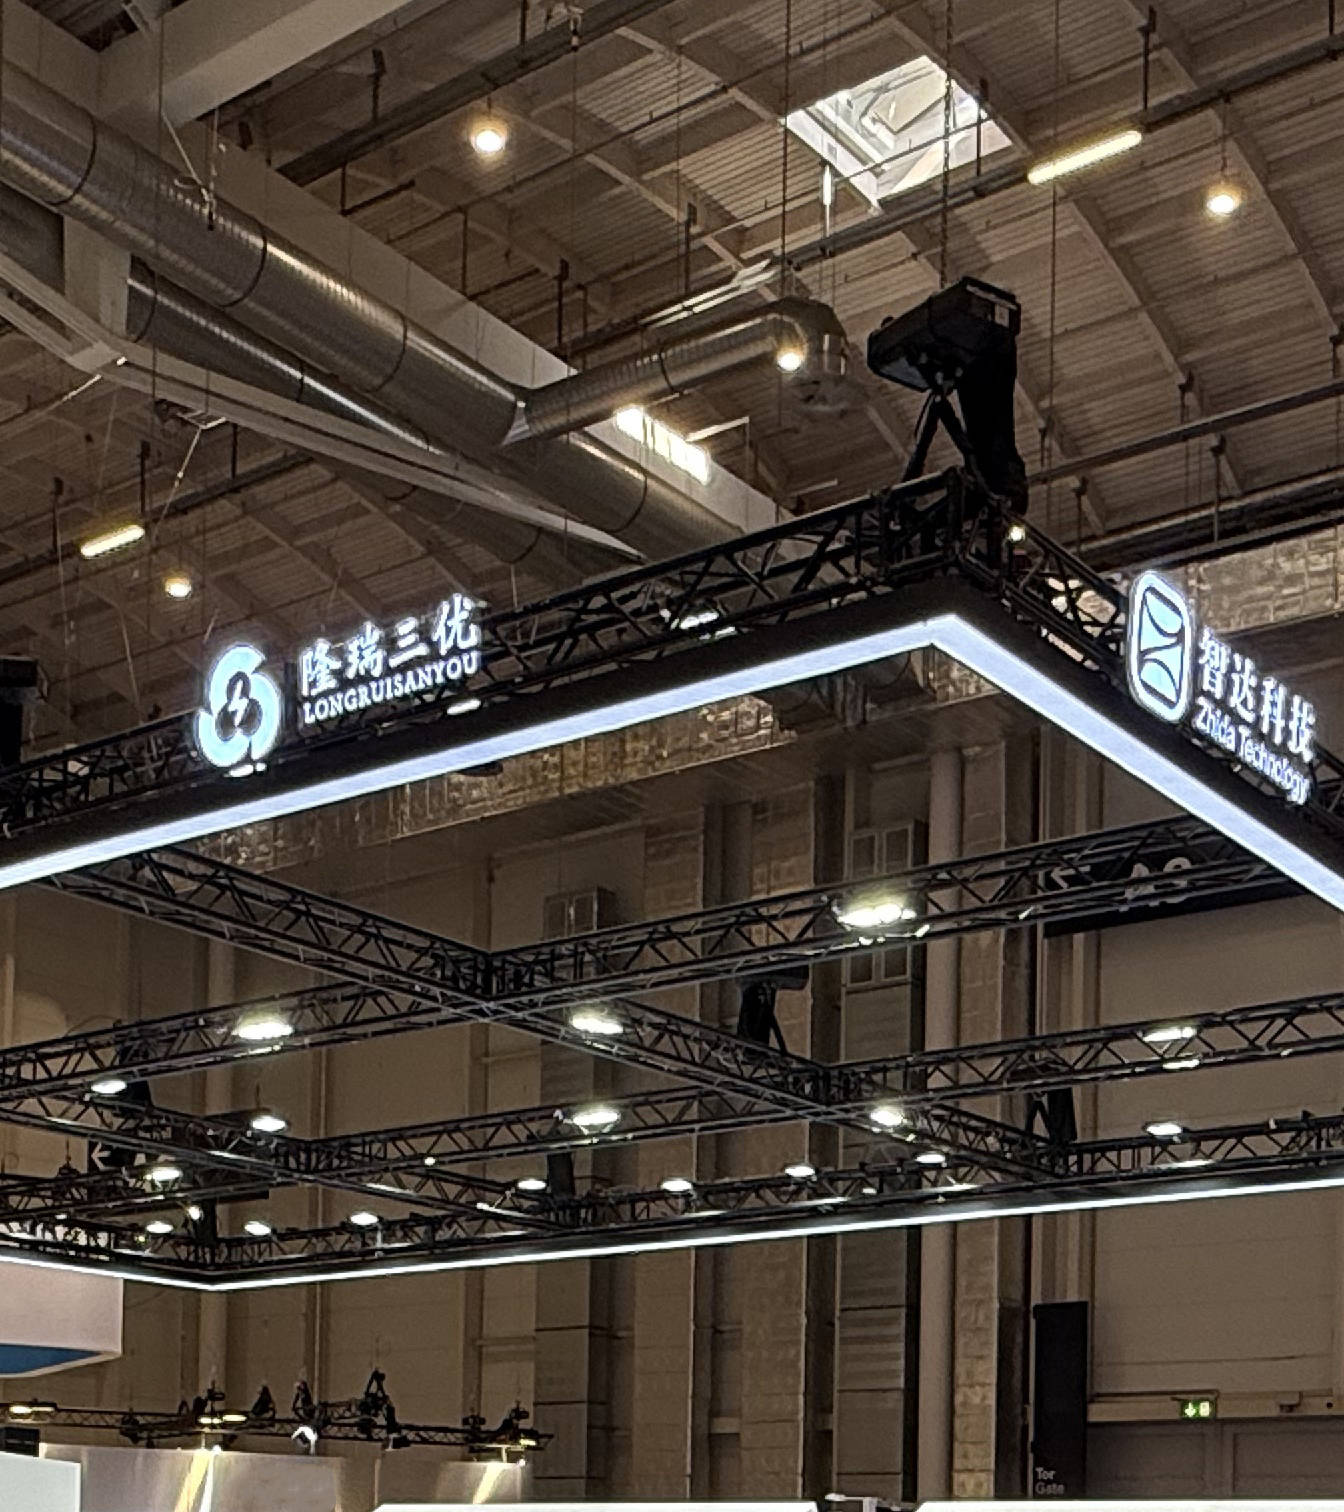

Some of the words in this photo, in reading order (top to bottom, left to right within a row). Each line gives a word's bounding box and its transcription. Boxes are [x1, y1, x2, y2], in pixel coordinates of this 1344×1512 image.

[301, 593, 481, 696] 隆瑞三优
[303, 652, 480, 724] LONGRUISANYOU
[1199, 625, 1316, 762] 智达科技
[1192, 697, 1237, 752] Zhida
[1239, 724, 1311, 805] Technology
